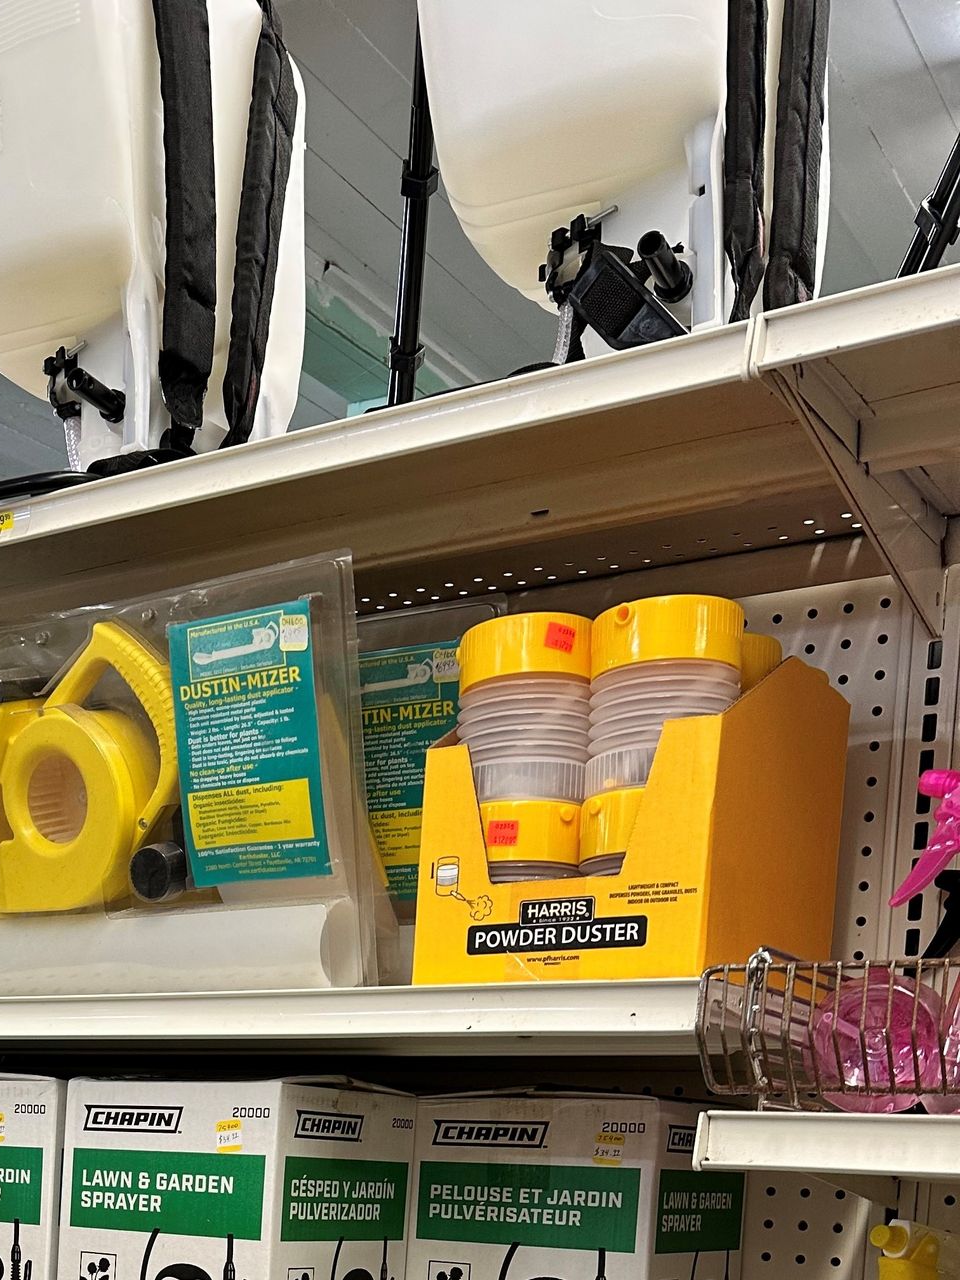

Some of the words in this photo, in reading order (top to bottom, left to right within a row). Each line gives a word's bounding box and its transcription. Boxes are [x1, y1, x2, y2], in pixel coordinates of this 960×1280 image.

[180, 666, 301, 701] DUSTIN-MIZER
[209, 693, 246, 706] long-lasting
[247, 689, 262, 698] dust
[263, 686, 294, 698] applicator
[362, 701, 455, 724] TIN-MIZER
[192, 792, 222, 802] Dispenses
[527, 900, 586, 919] HARRIS
[474, 928, 556, 949] POWDER
[561, 922, 639, 945] DUSTER
[92, 1111, 175, 1127] CHAPIN
[232, 1107, 270, 1118] 20000
[300, 1117, 358, 1135] CHAPIN
[392, 1117, 413, 1130] 20000
[602, 1122, 646, 1134] 20000
[441, 1126, 538, 1142] CHAPIN
[82, 1168, 132, 1188] LAWN
[138, 1170, 150, 1189] &
[156, 1173, 234, 1194] GARDEN
[291, 1173, 340, 1198] CÉSPED
[342, 1182, 349, 1199] Y
[351, 1178, 395, 1200] JARDÍN
[81, 1191, 162, 1213] SPRAYER
[430, 1184, 513, 1203] PELOUSE
[519, 1187, 543, 1204] ET
[546, 1189, 622, 1209] JARDIN
[290, 1202, 380, 1221] PULVERIZADOR
[428, 1202, 582, 1226] PULVÉRISATEUR
